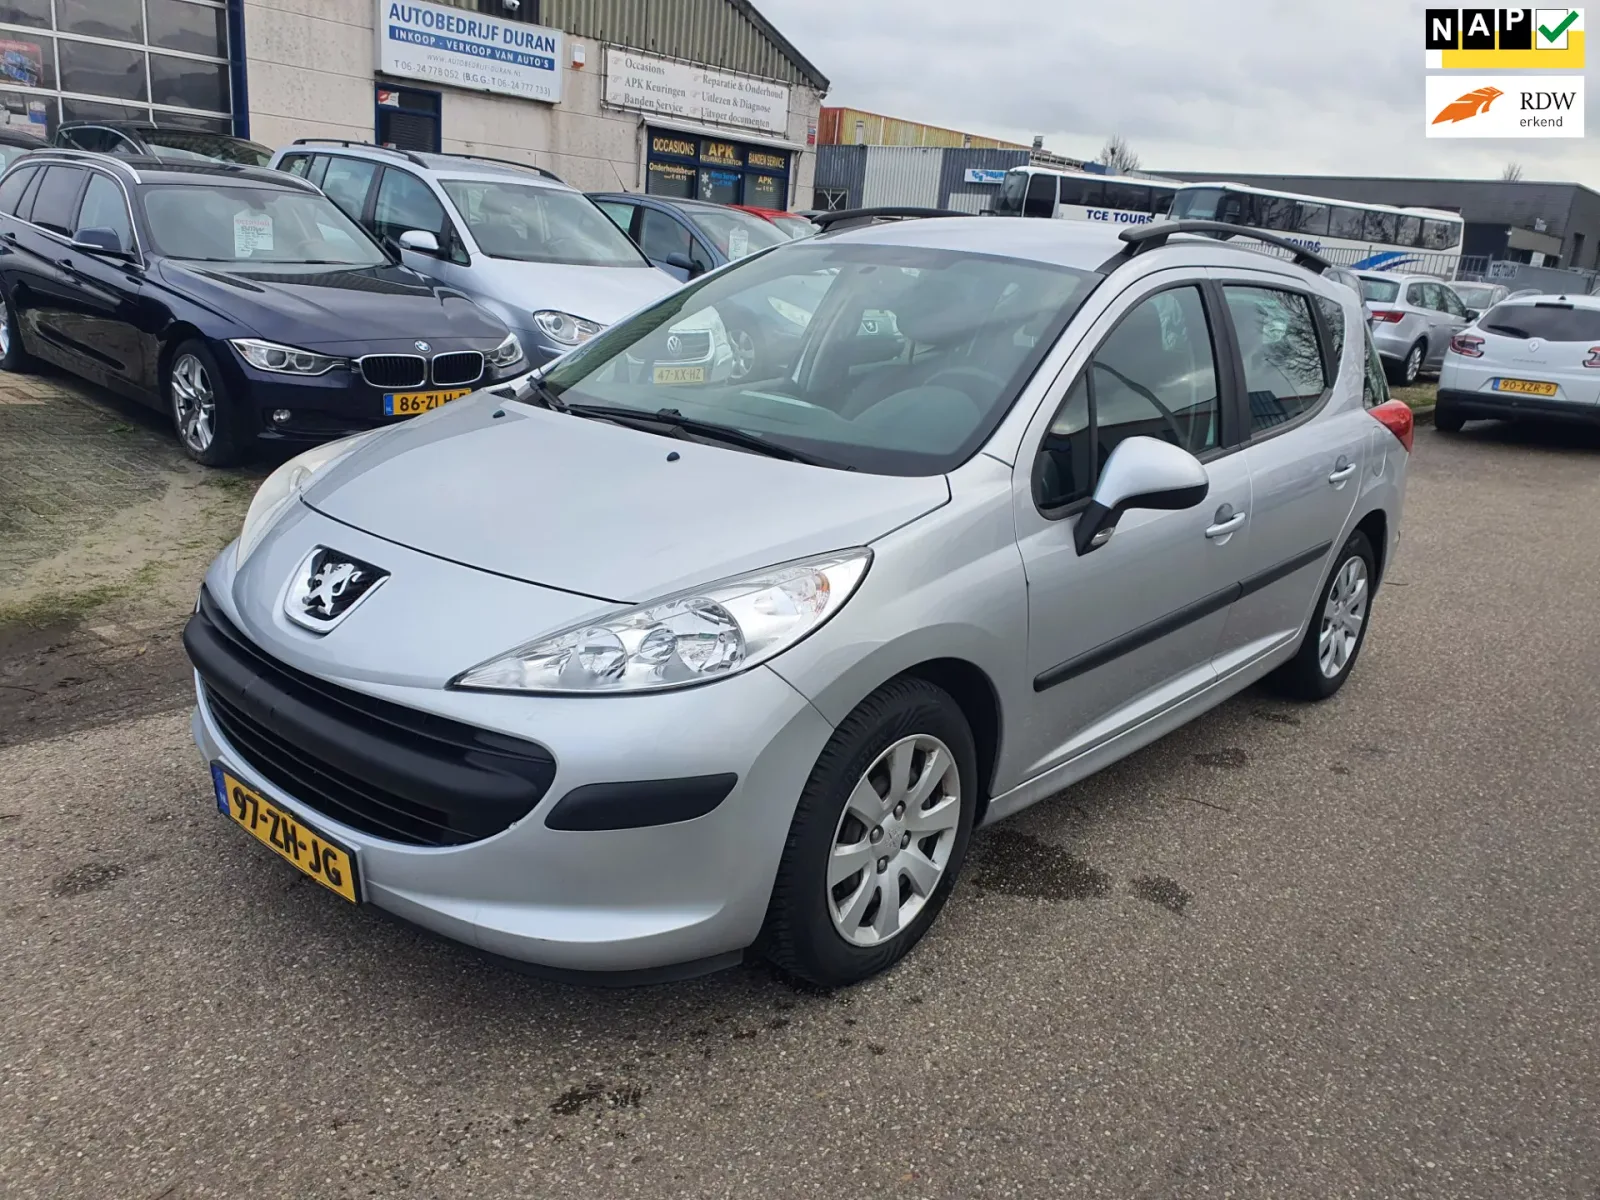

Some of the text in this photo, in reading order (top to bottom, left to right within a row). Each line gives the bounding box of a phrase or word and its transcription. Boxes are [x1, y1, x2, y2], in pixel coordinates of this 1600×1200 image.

[389, 3, 555, 53] AUTOBEDRIJF DURAN
[395, 29, 436, 46] INKOOP
[446, 40, 491, 57] VERKOOP
[495, 49, 514, 62] VAN
[517, 53, 549, 68] AUTO'S
[624, 58, 665, 75] Occasions
[624, 76, 686, 99] APK Keuringen
[702, 74, 737, 91] Reparatie
[745, 83, 784, 100] Onderhoud
[624, 93, 684, 113] Banden Service
[701, 91, 731, 106] Uitlezen
[739, 98, 771, 115] Diagnose
[728, 110, 770, 128] documenten
[653, 138, 695, 156] OCCASIONS
[708, 142, 734, 158] APK
[758, 175, 773, 185] APK
[1086, 209, 1154, 225] TCE TOURS
[1502, 380, 1552, 394] 90-XZR-9
[232, 786, 342, 887] 97-ZH-JG
